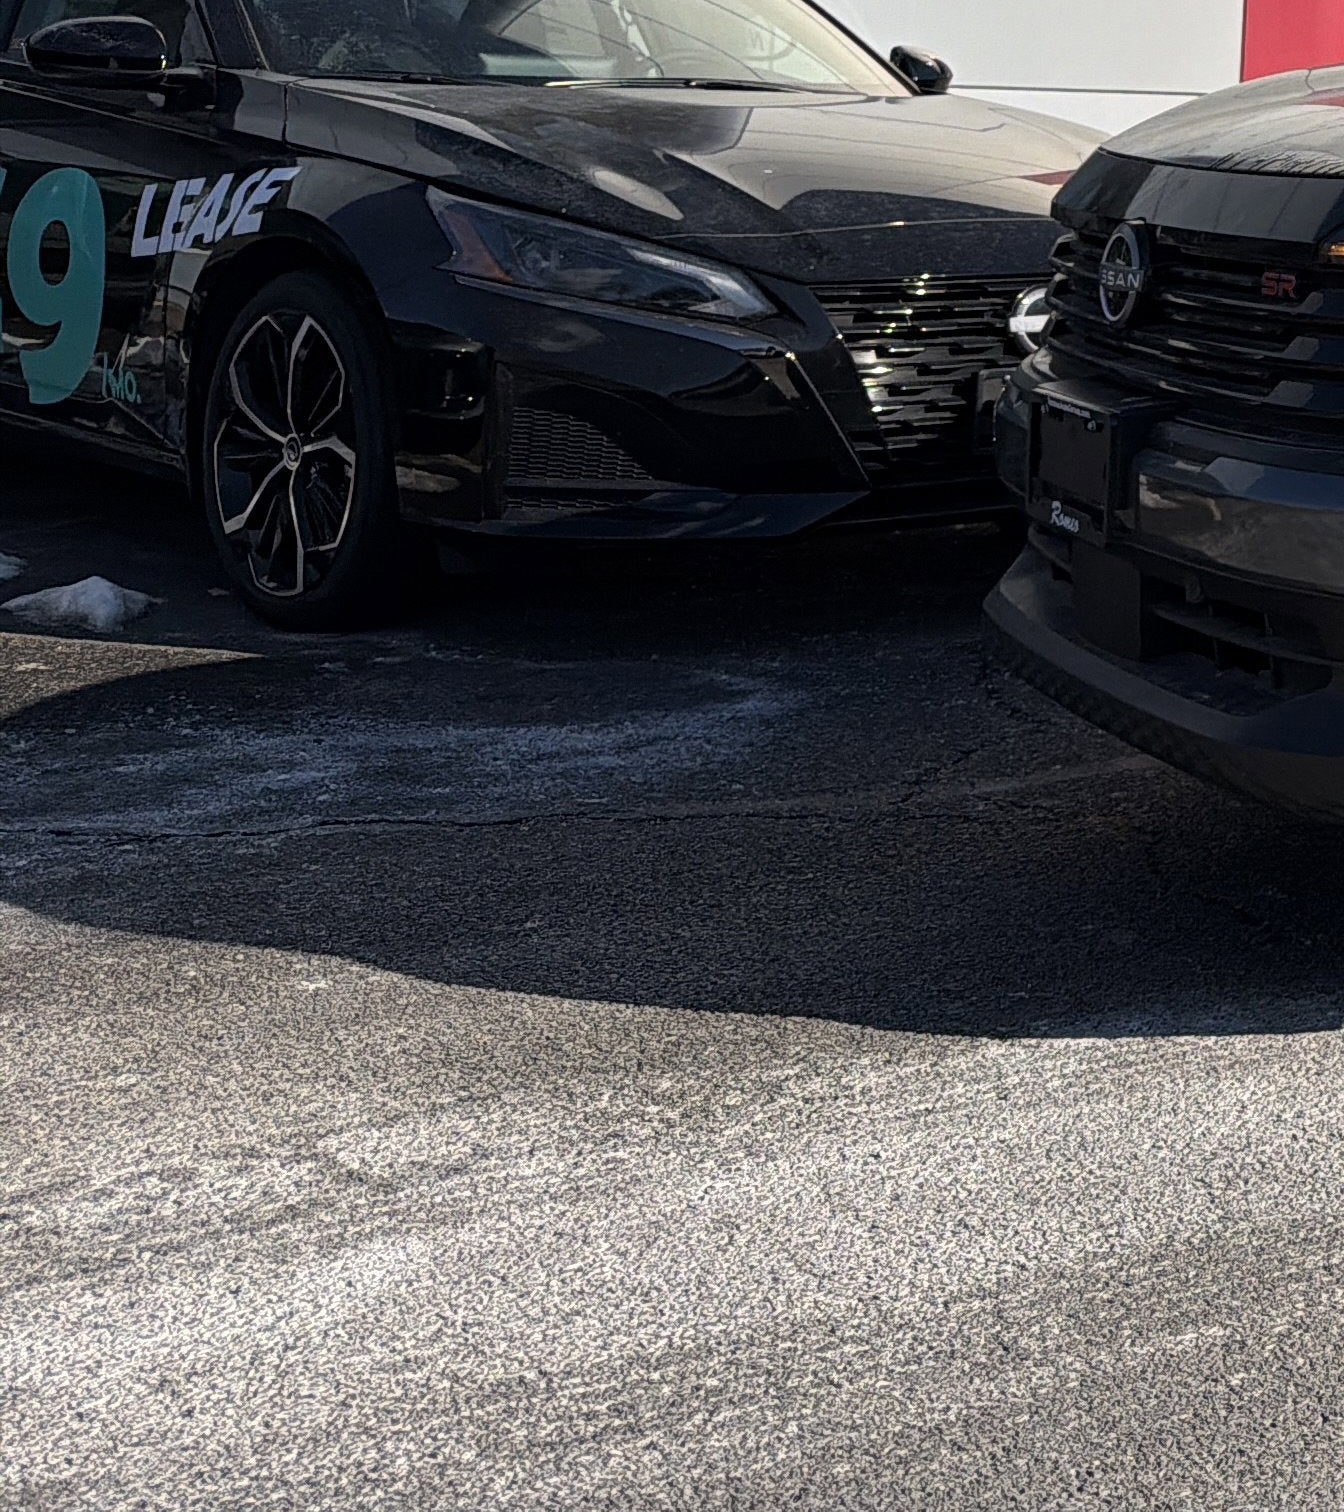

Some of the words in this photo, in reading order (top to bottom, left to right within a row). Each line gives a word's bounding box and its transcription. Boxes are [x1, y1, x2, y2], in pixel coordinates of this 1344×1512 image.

[0, 167, 106, 404] 9
[131, 166, 301, 257] LEASE
[1261, 271, 1296, 299] SR
